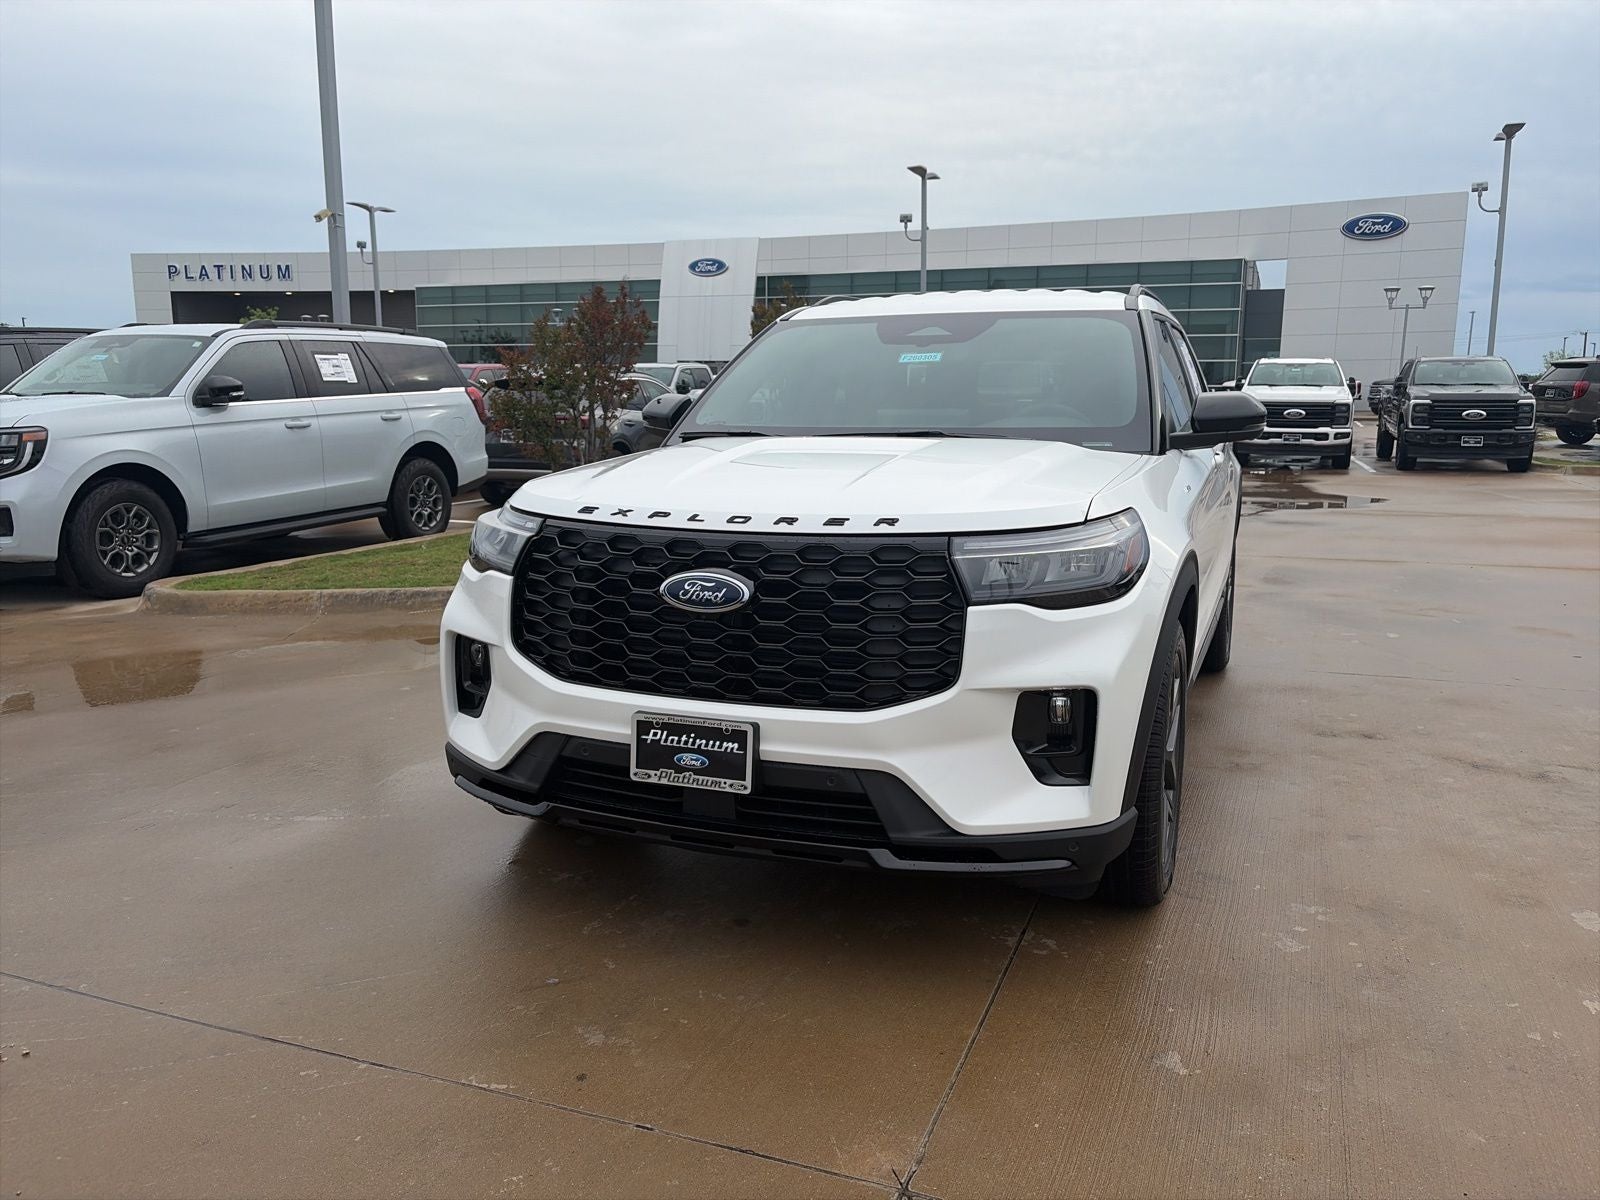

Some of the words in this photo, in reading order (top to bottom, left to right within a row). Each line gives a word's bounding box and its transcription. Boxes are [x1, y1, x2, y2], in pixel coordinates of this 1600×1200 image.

[1354, 218, 1393, 234] Ford
[167, 264, 294, 281] PLATINUM
[695, 261, 718, 271] Ford
[577, 505, 900, 527] EXPLORER
[679, 580, 727, 603] Ford
[643, 715, 742, 728] www.PlatinumFord.com
[641, 729, 744, 753] Platinum
[680, 755, 702, 767] Ford
[658, 769, 726, 789] Platinum
